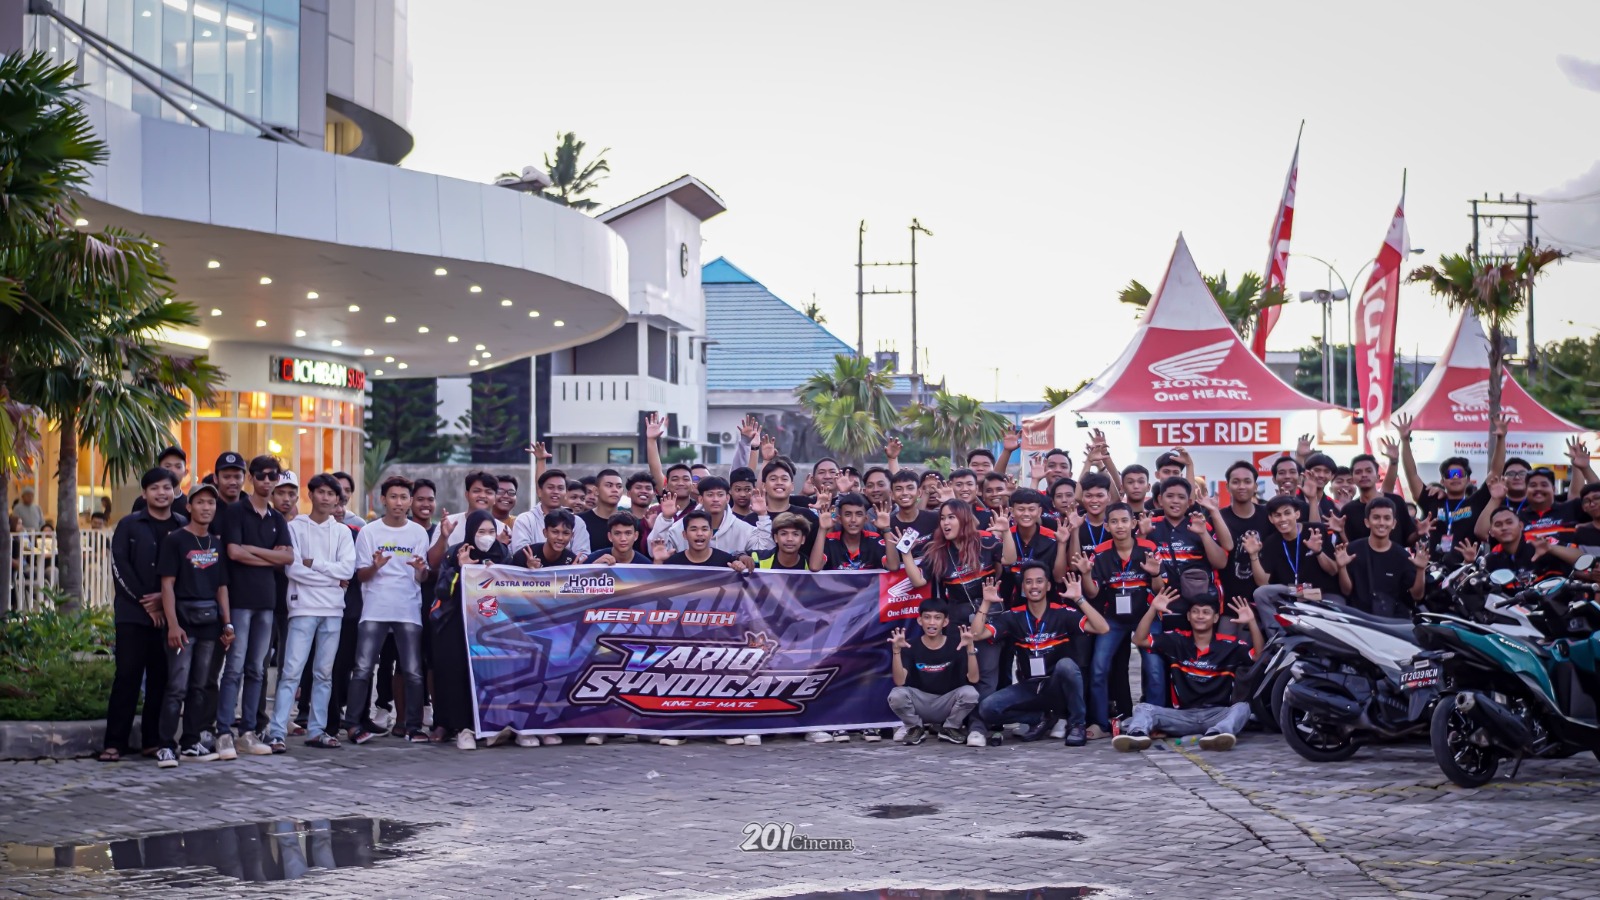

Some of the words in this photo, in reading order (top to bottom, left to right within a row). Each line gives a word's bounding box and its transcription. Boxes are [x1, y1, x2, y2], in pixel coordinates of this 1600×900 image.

[294, 358, 347, 387] ICHIBAN
[347, 367, 366, 390] SUSH
[1151, 378, 1248, 389] HONDA
[1154, 391, 1189, 402] One
[1192, 389, 1252, 401] HEART.
[1453, 413, 1478, 422] One
[1152, 422, 1210, 444] TEST
[1214, 421, 1268, 443] RIDE
[569, 574, 614, 587] Honda
[887, 593, 923, 604] HONDA
[585, 609, 644, 622] MEET
[650, 611, 678, 623] UP
[683, 611, 736, 625] WITH
[887, 609, 899, 618] One
[901, 606, 920, 615] HEAR
[621, 643, 764, 672] VARIO
[575, 671, 829, 698] SYNDICATE
